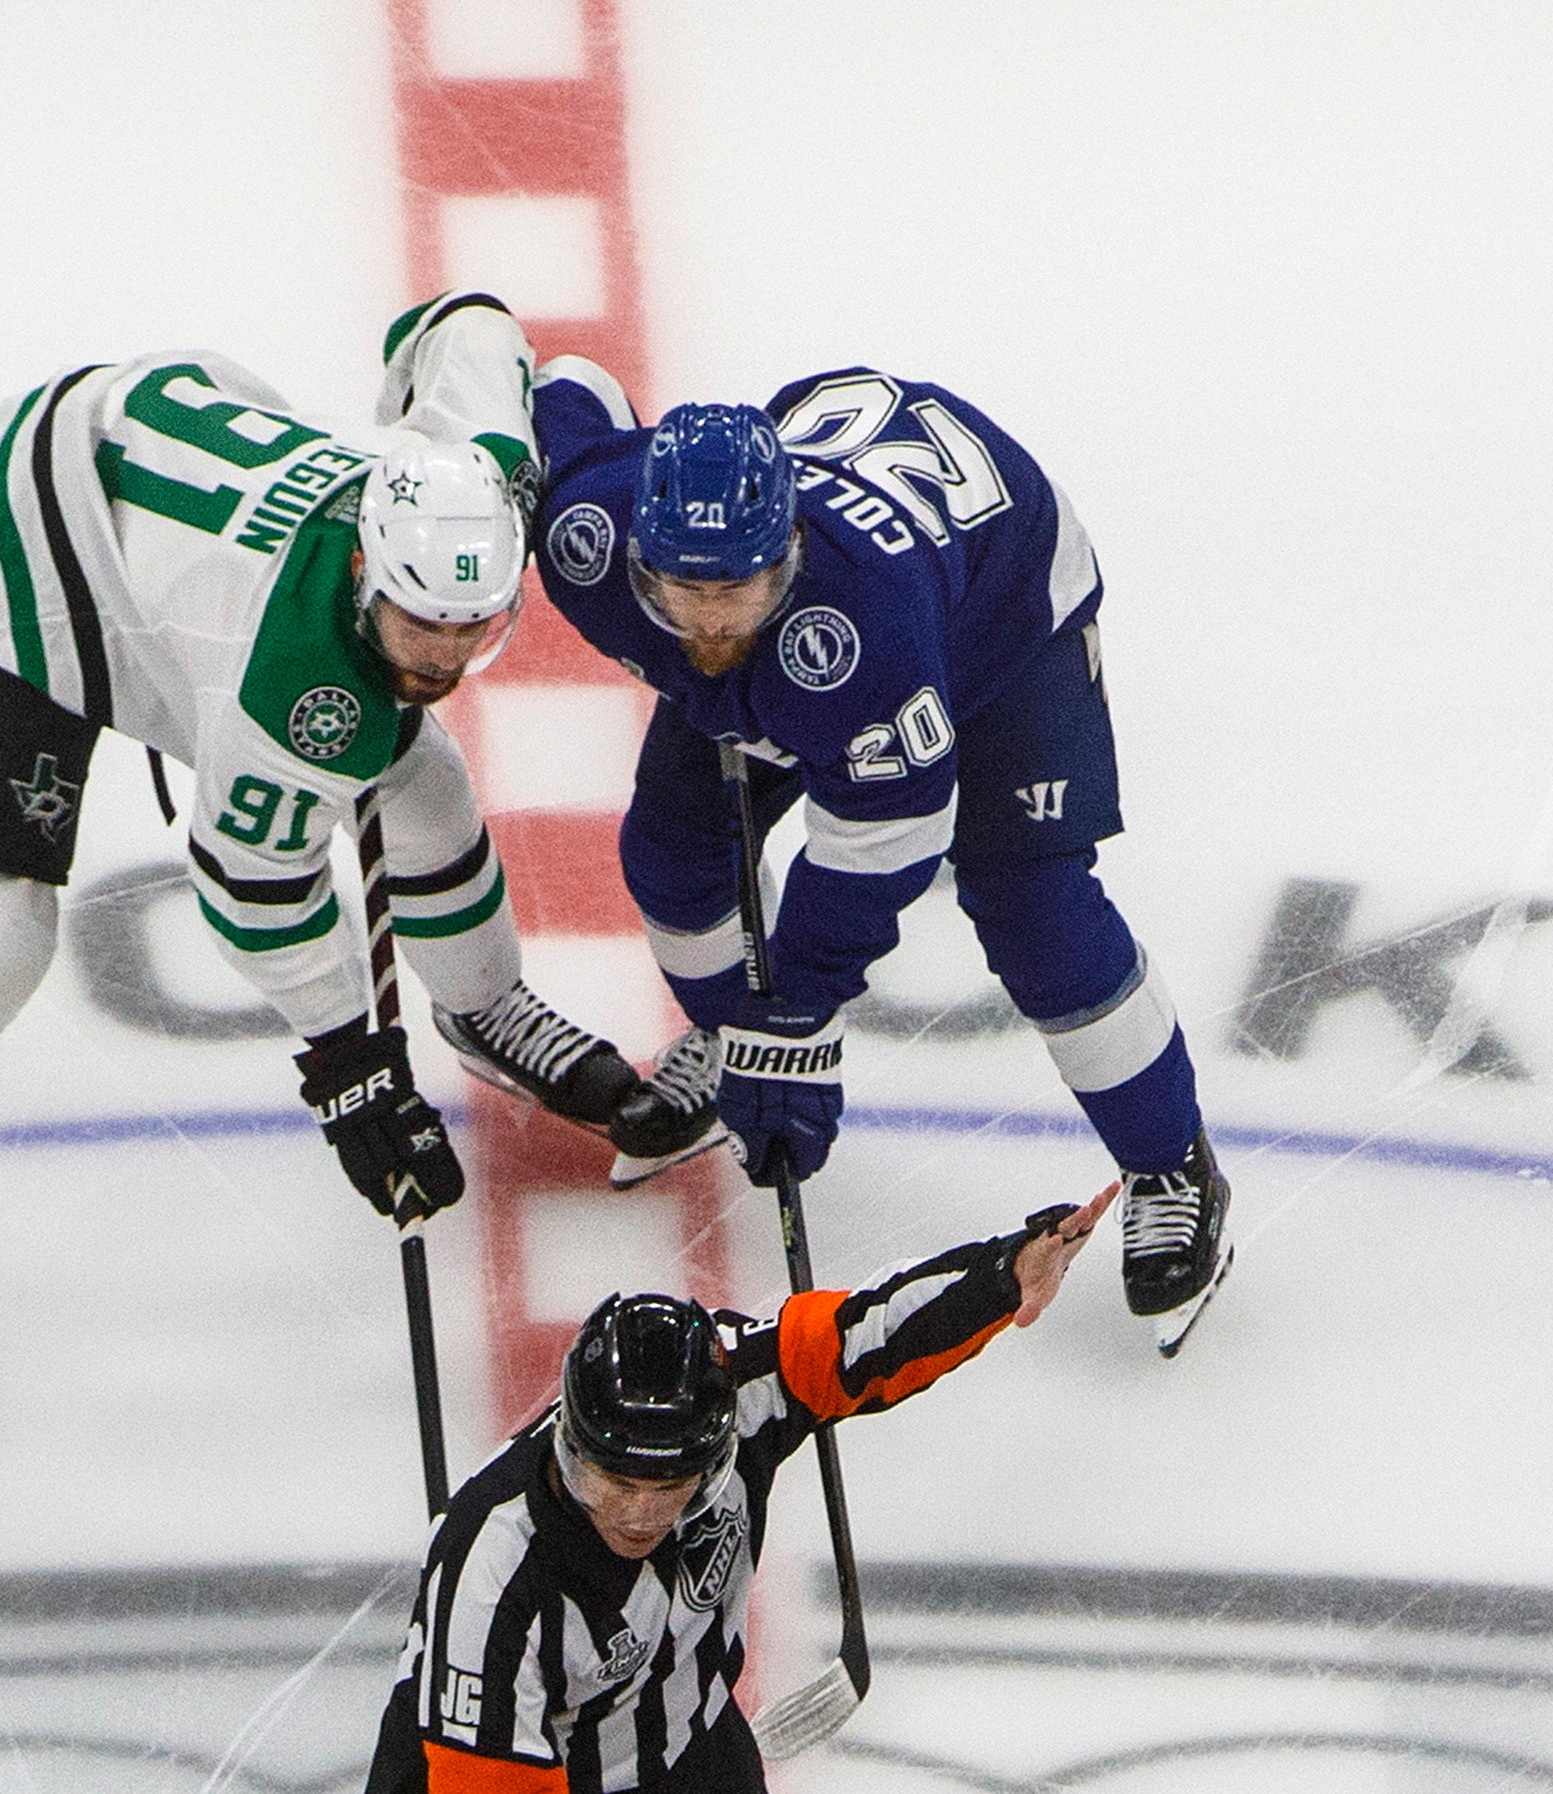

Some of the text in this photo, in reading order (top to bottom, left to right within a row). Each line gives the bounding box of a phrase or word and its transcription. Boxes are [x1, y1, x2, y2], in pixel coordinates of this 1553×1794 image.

[98, 363, 332, 536] 91
[778, 373, 1014, 548] 20
[235, 445, 380, 555] EGUIN
[688, 502, 726, 529] 20
[793, 460, 915, 556] COLE
[455, 554, 480, 582] 91
[846, 686, 956, 782] 20
[215, 774, 319, 853] 91
[313, 1068, 395, 1124] UER
